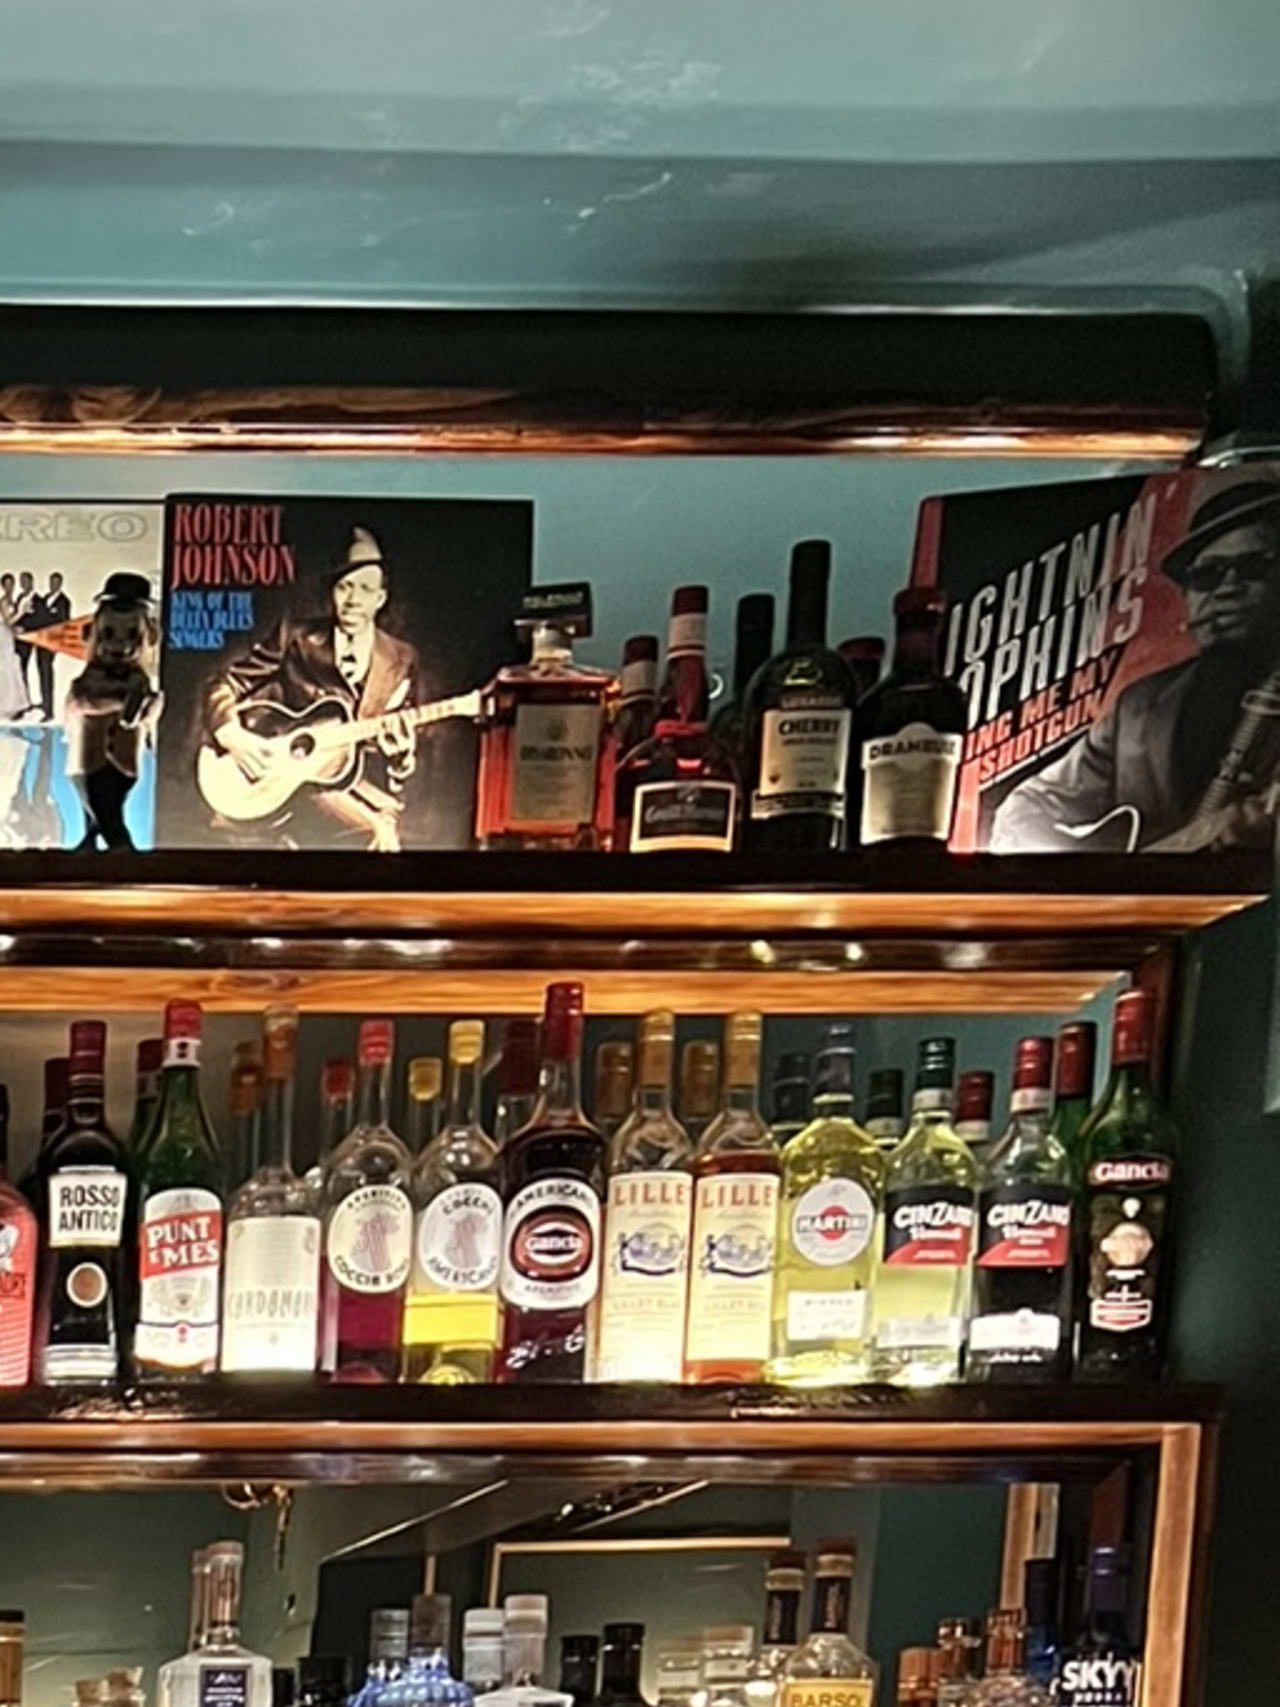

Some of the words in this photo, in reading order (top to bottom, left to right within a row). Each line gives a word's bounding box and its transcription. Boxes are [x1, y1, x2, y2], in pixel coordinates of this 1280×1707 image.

[174, 503, 283, 545] ROBERT
[171, 544, 296, 590] JOHNSON
[964, 710, 1013, 760] ING
[1019, 681, 1063, 730] ME
[1069, 650, 1118, 700] MY
[978, 688, 1107, 786] SHOTGUN
[59, 1184, 120, 1207] ROSSO
[58, 1208, 119, 1232] ANTICO
[146, 1216, 212, 1248] PUNT
[797, 1215, 868, 1233] MARTINI
[162, 1241, 219, 1268] MES
